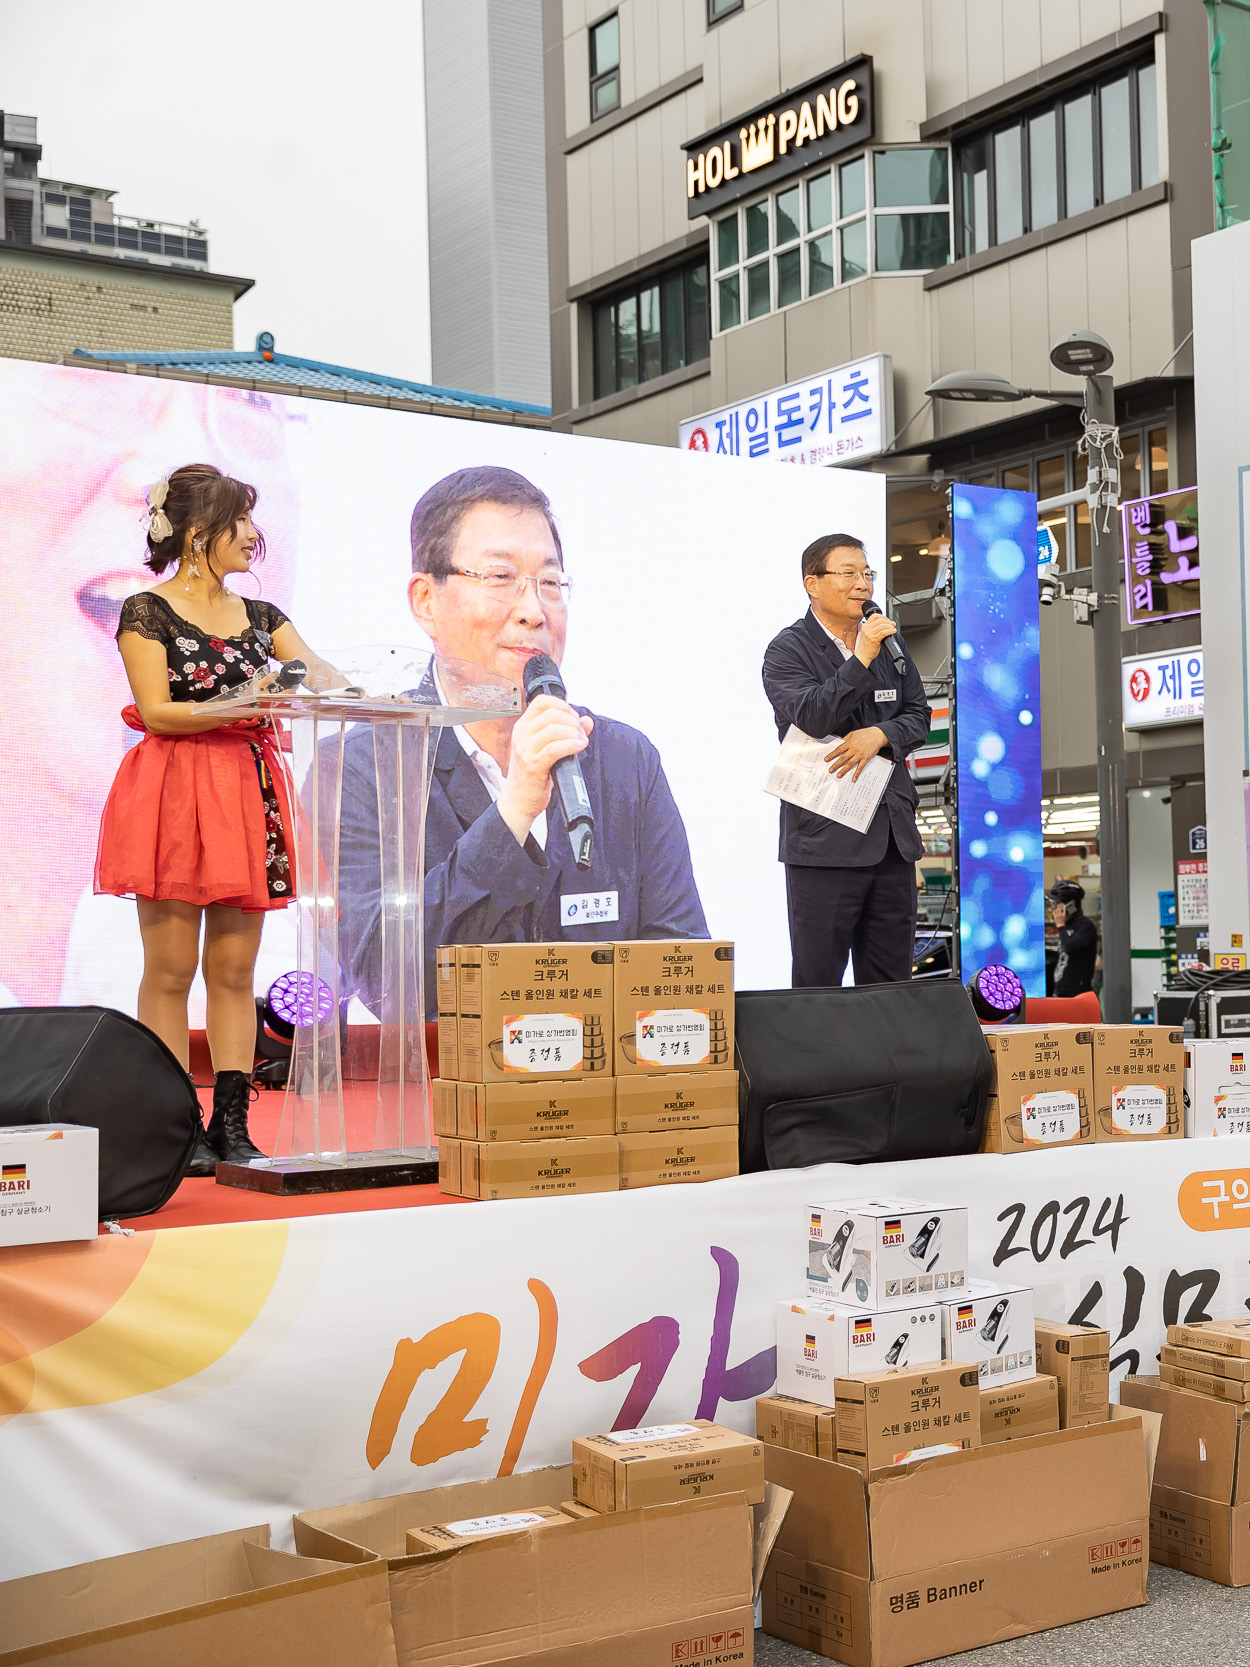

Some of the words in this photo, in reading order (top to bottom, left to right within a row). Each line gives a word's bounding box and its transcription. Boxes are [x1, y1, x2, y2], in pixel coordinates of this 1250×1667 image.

[687, 139, 739, 198] HOL
[779, 79, 860, 156] PANG
[715, 371, 873, 458] 제일돈카츠
[535, 956, 568, 965] KRÜGER
[662, 953, 693, 962] KRÜGER
[533, 969, 569, 982] 크루거
[661, 966, 694, 978] 크루거
[500, 989, 521, 1001] 스텐
[524, 988, 555, 1000] 올인원
[559, 988, 579, 999] 채칼
[583, 988, 602, 999] 세트
[630, 985, 650, 996] 스텐
[653, 985, 681, 995] 올인원
[685, 984, 704, 995] 채칼
[707, 984, 725, 994] 세트
[1035, 1041, 1059, 1049] KRÜGER
[1034, 1050, 1061, 1063] 크루거
[1129, 1048, 1154, 1059] 크루거
[1011, 1071, 1026, 1081] 스텐
[1029, 1069, 1051, 1080] 올인원
[1053, 1067, 1068, 1078] 채칼
[1071, 1065, 1086, 1075] 세트
[1106, 1065, 1121, 1075] 스텐
[1122, 1064, 1144, 1075] 올인원
[1146, 1064, 1161, 1074] 채칼
[1162, 1064, 1176, 1073] 세트
[1229, 1063, 1246, 1073] BARI
[664, 1101, 695, 1109] KRÜGER
[536, 1109, 569, 1118] KRÜGER
[665, 1156, 696, 1165] KRÜGER
[537, 1167, 571, 1176] KRÜGER
[0, 1179, 31, 1192] BARI
[16, 1205, 51, 1216] 살균청소기
[809, 1226, 823, 1238] BARI
[993, 1193, 1130, 1267] 2024
[882, 1233, 905, 1246] BARI
[955, 1317, 977, 1331] BARI
[852, 1332, 876, 1345] BARI
[1202, 1338, 1222, 1349] GRIDDLE
[1222, 1342, 1234, 1351] PAN
[803, 1347, 818, 1359] BARI
[1198, 1357, 1216, 1367] GRIDDLE
[1216, 1360, 1226, 1370] PAN
[911, 1385, 940, 1397] KRÜGER
[1197, 1379, 1216, 1390] GRIDDLE
[1216, 1383, 1226, 1393] PAN
[910, 1396, 941, 1413] 크루거
[882, 1423, 900, 1437] 스텐
[903, 1418, 930, 1433] 올인원
[933, 1414, 951, 1428] 채칼
[954, 1411, 972, 1424] 세트
[1091, 1564, 1111, 1575] Made
[1121, 1556, 1143, 1568] Korea
[889, 1589, 921, 1615] 명품
[926, 1577, 985, 1604] Banner
[715, 1652, 745, 1664] Korea
